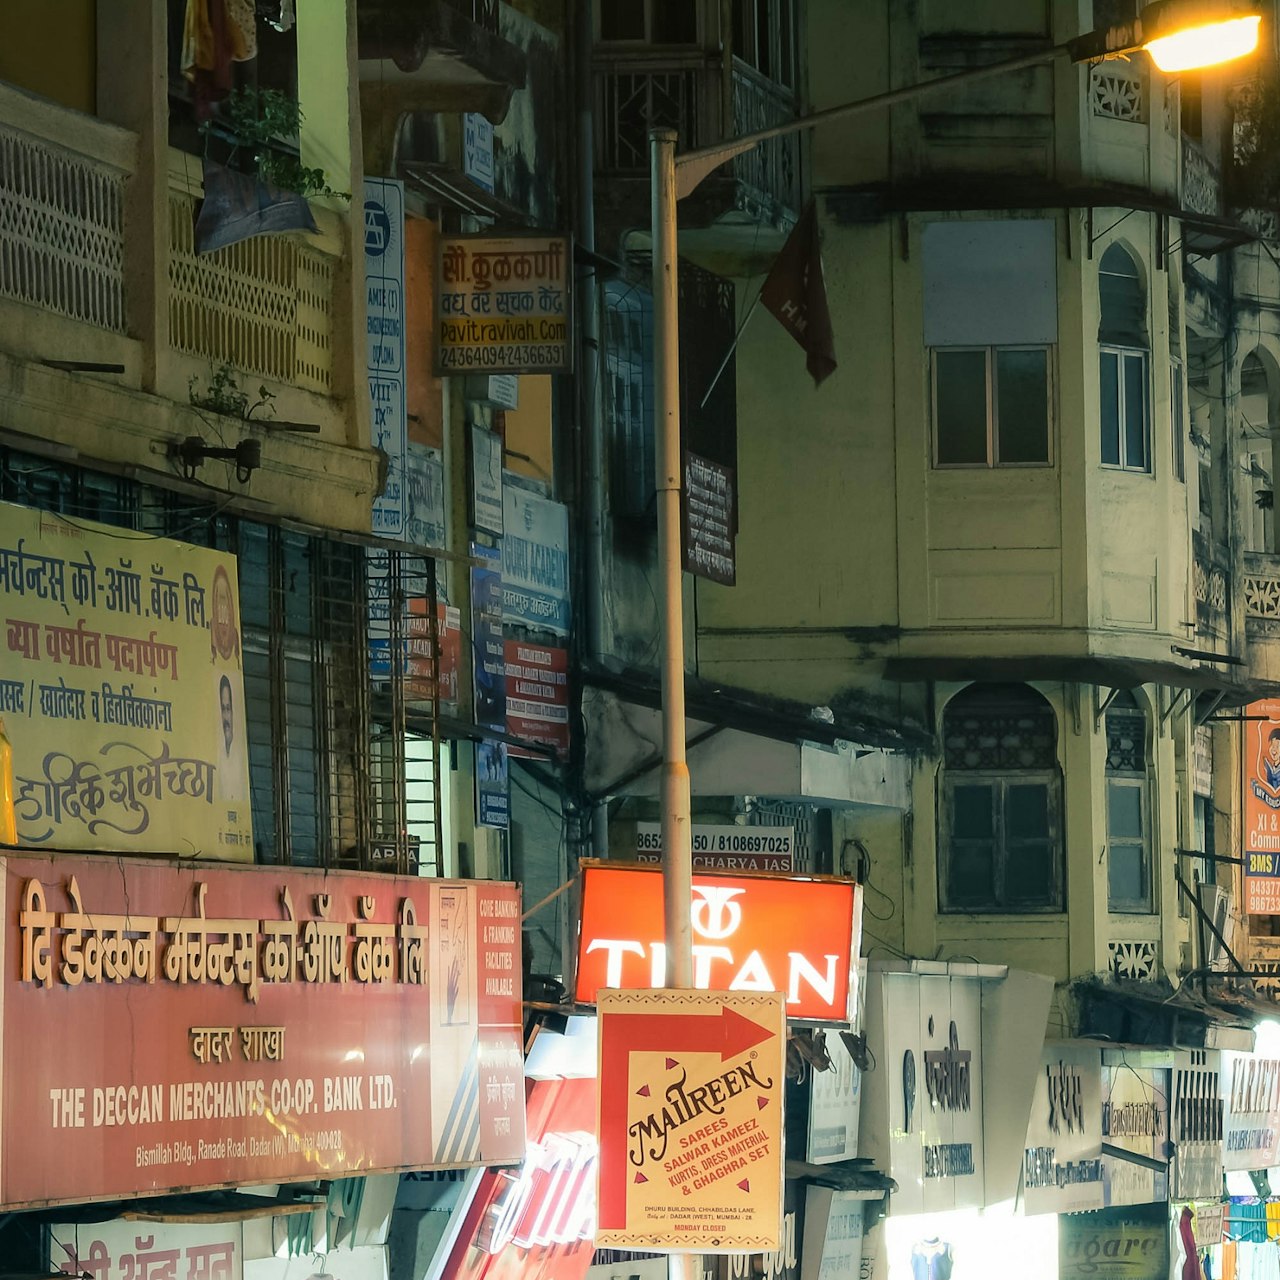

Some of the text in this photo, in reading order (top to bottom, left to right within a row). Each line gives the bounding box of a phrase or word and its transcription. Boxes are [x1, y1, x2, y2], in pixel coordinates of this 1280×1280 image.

[472, 291, 491, 313] वर
[45, 618, 101, 669] वर्षात
[105, 631, 178, 681] पदार्पण
[1258, 814, 1267, 832] XI
[1270, 815, 1278, 832] &
[719, 836, 790, 852] 8108697025
[1250, 854, 1273, 873] BMS
[494, 899, 518, 919] BANKING
[20, 878, 55, 989] दि
[61, 875, 158, 986] डेक्कन
[488, 926, 515, 944] FRANKING
[485, 952, 512, 970] FACILITIES
[586, 938, 840, 1006] TITAN
[485, 979, 513, 996] AVAILABLE
[191, 1026, 286, 1063] दादर शाखा
[50, 1087, 85, 1128] THE
[93, 1084, 163, 1127] DECCAN
[170, 1079, 265, 1122] MERCHANTS
[324, 1076, 363, 1113] BANK
[369, 1074, 398, 1110] LTD.
[630, 1066, 773, 1166] MAITREEN
[136, 1144, 172, 1168] Bismillah
[198, 1139, 226, 1160] Ranade
[250, 1136, 271, 1157] Dadar
[287, 1132, 315, 1153] Mumbai
[663, 1118, 759, 1172] SALWAR KAMEEZ
[679, 1118, 729, 1149] SAREES
[700, 1150, 729, 1170] DRESS
[729, 1130, 770, 1156] MATERIAL
[682, 1145, 770, 1195] & GHAGHRA SET
